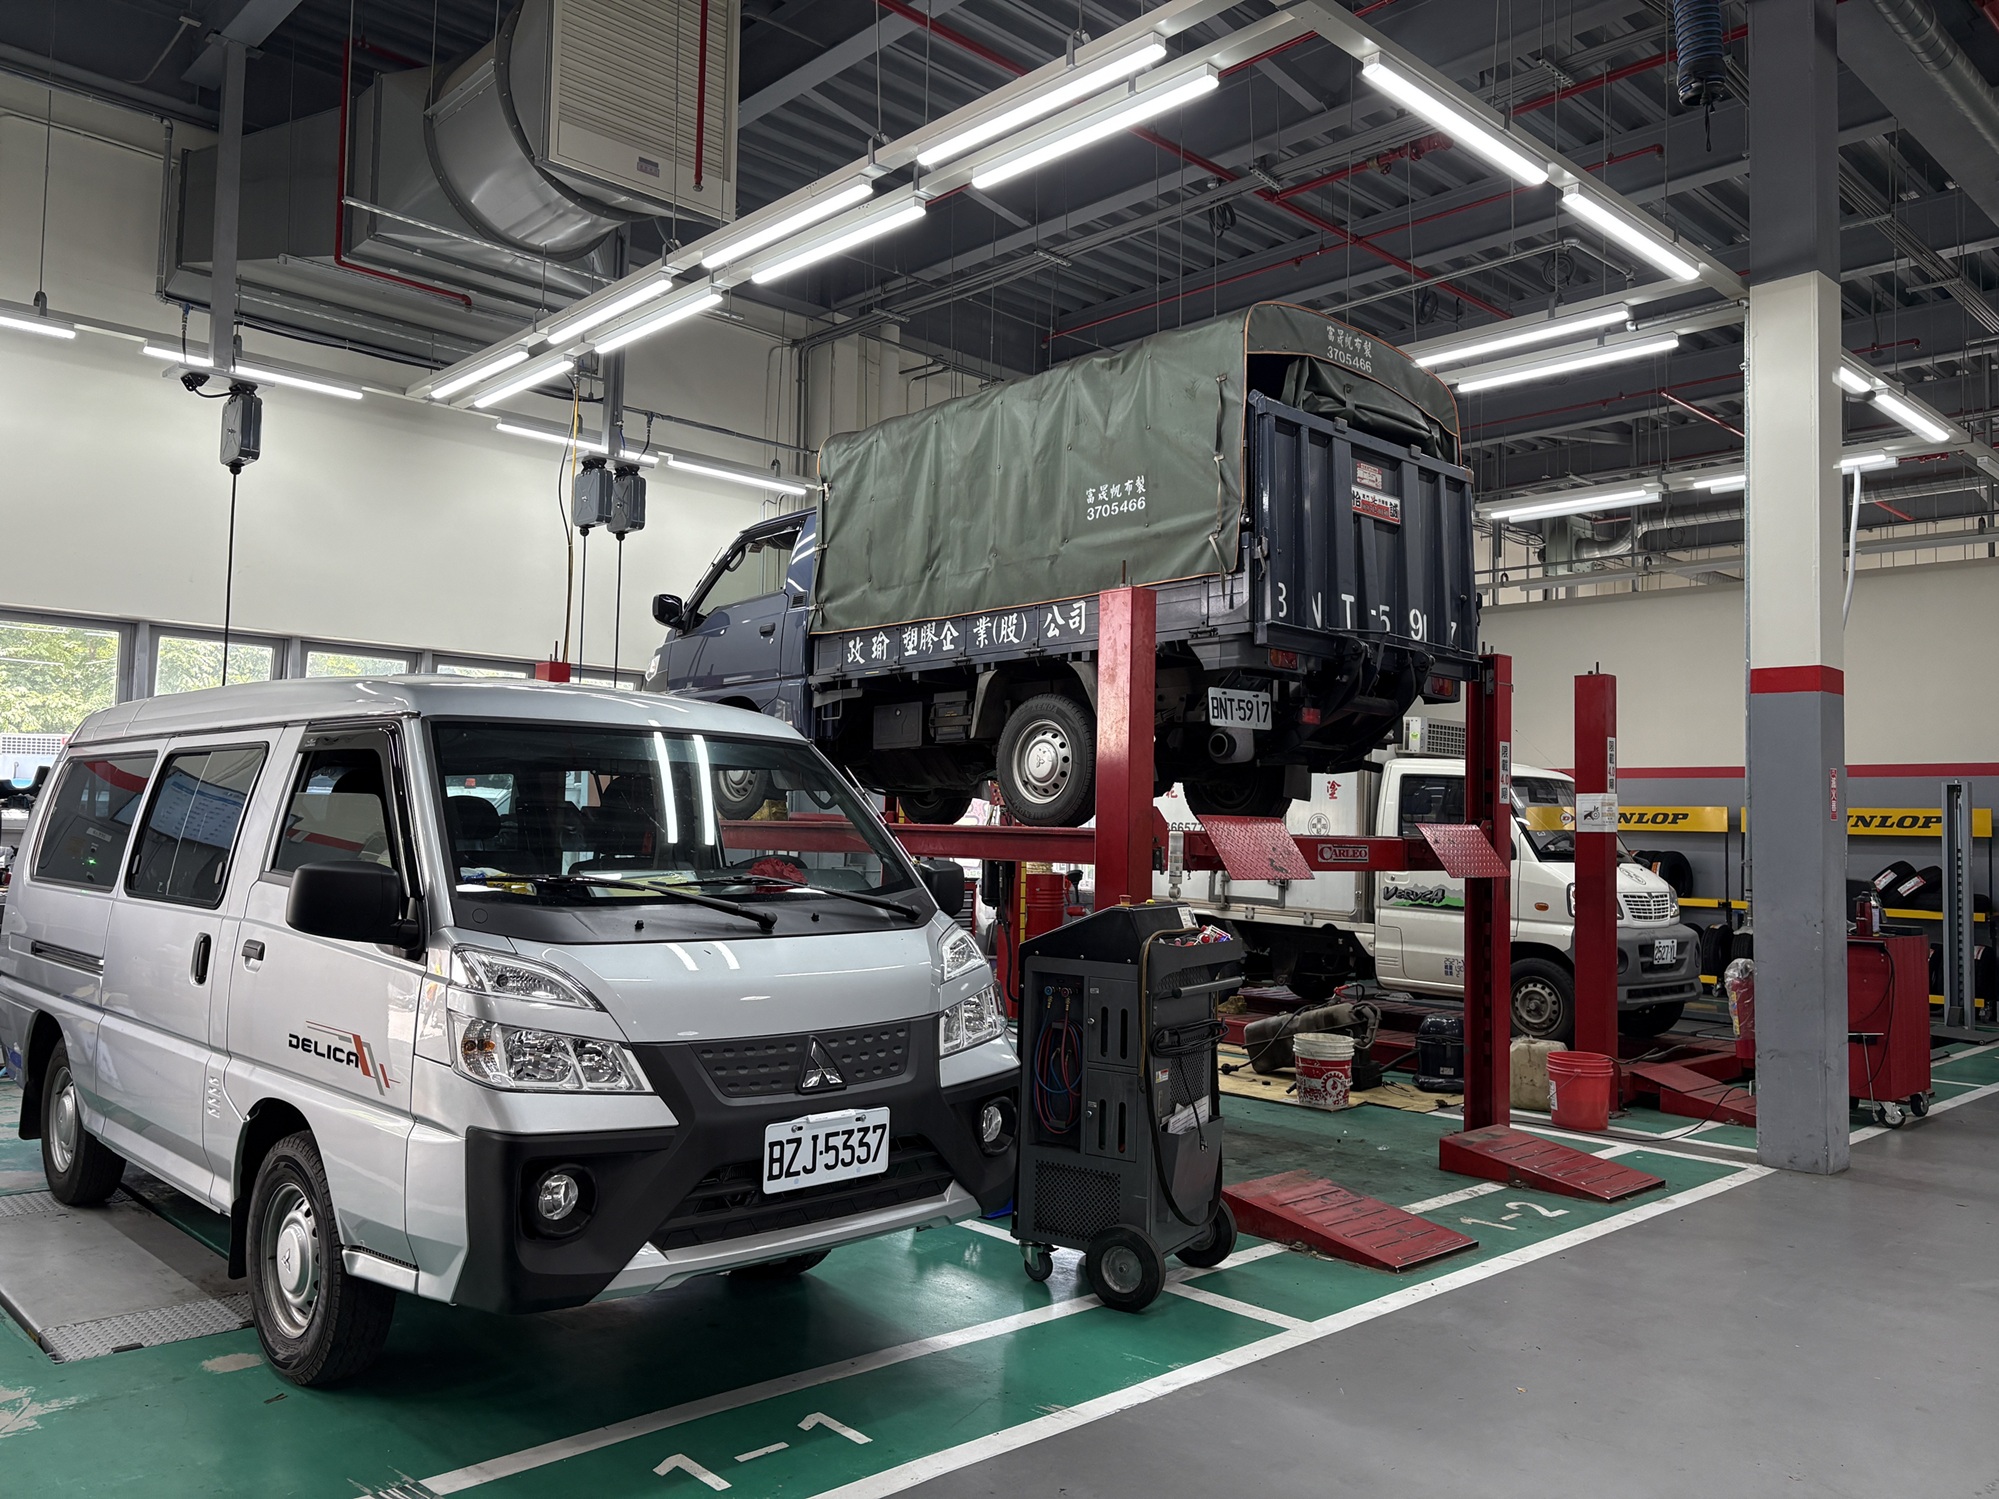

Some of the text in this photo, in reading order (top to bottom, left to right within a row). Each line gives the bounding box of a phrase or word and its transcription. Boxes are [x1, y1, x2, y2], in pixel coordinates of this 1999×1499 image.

[1327, 345, 1372, 373] 3705466
[1086, 475, 1146, 504] 富晟帆布製
[1087, 496, 1146, 520] 3705466
[1326, 780, 1342, 800] 塗
[1318, 846, 1368, 861] CARLEO
[288, 1032, 360, 1069] DELICA
[1459, 1201, 1570, 1231] 1-2
[651, 1411, 874, 1492] 1-1
